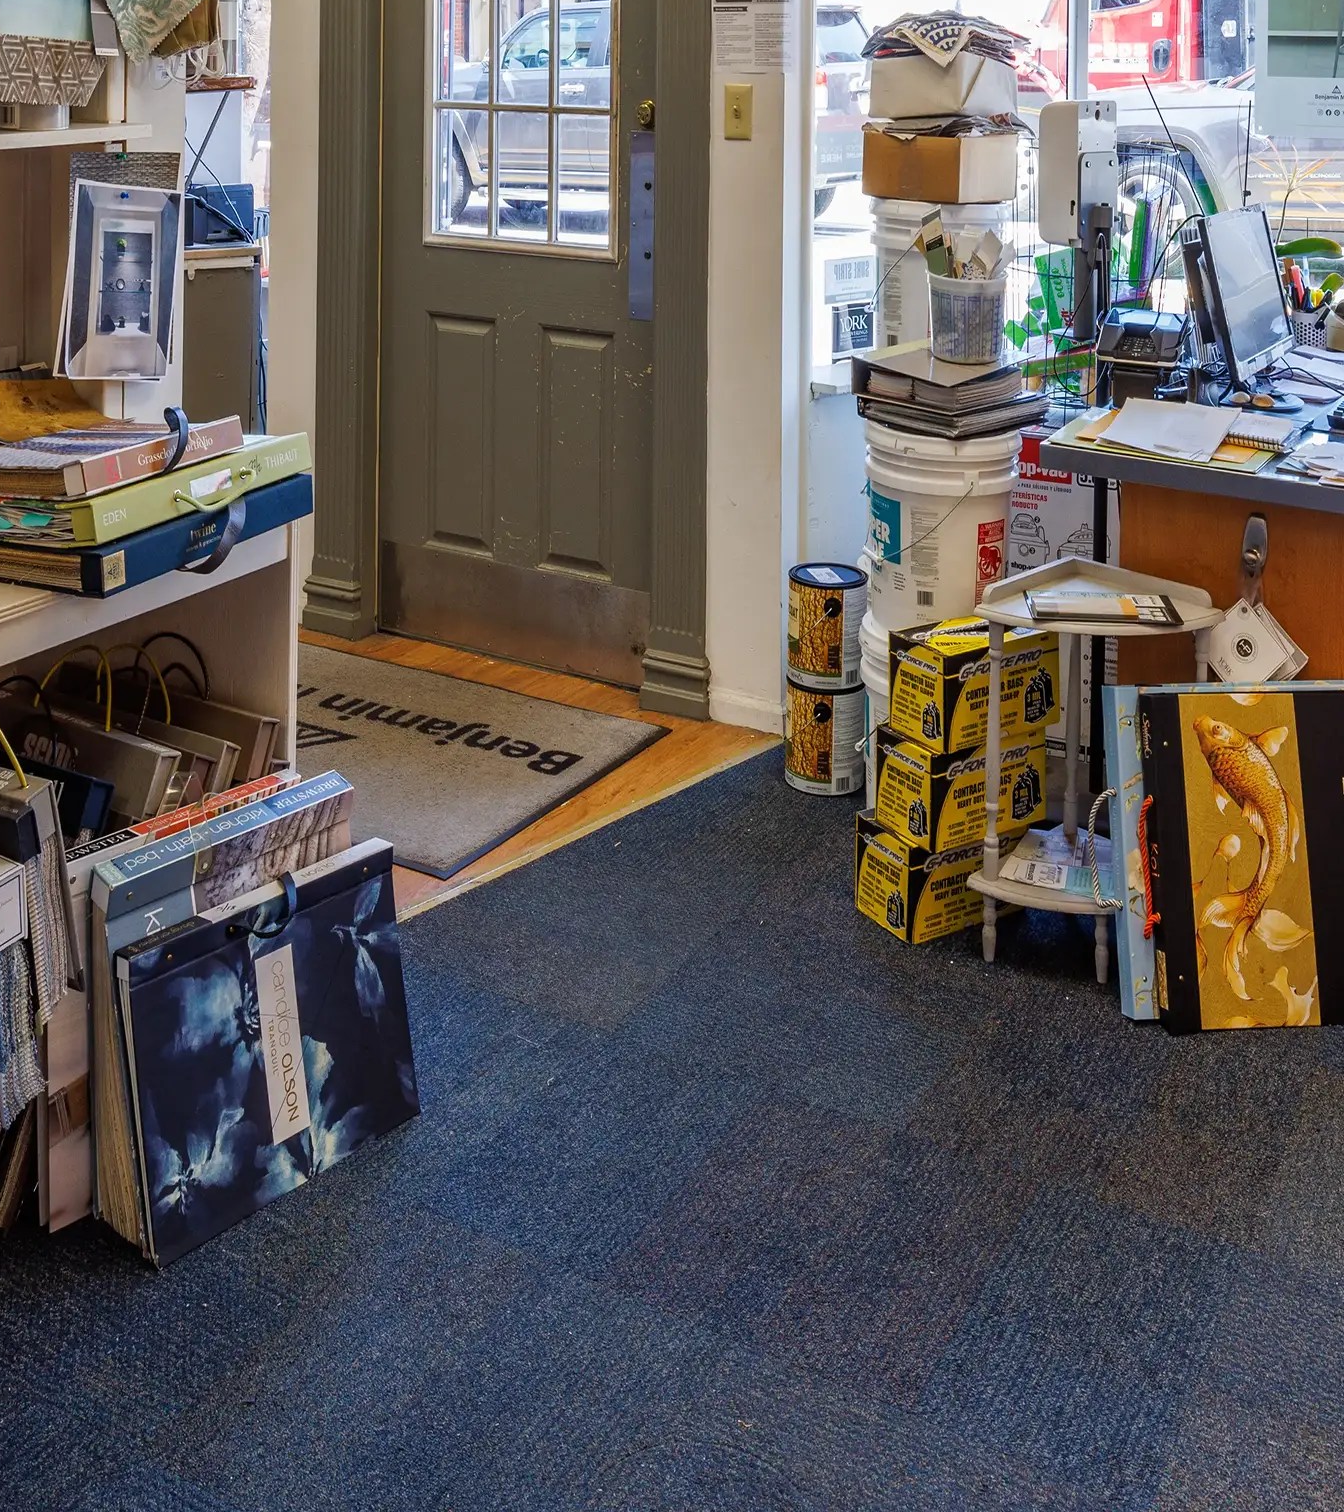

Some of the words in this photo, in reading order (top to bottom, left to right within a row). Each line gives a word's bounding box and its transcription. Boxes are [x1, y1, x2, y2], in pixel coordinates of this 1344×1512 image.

[840, 314, 867, 332] YORK
[264, 448, 298, 470] THIBAUT
[102, 508, 127, 527] EDEN
[897, 651, 923, 667] G-FORCE
[923, 663, 937, 672] PRO
[1015, 650, 1042, 665] PRO
[1006, 677, 1024, 688] BAGS
[319, 692, 584, 775] Benjamin
[883, 746, 909, 765] G-FORCE
[910, 760, 924, 771] PRO
[272, 778, 340, 810] BREWSTER
[890, 852, 903, 863] PRO
[268, 1020, 278, 1076] TRANQUIL
[272, 960, 291, 1048] candice
[282, 1052, 299, 1122] OLSON
